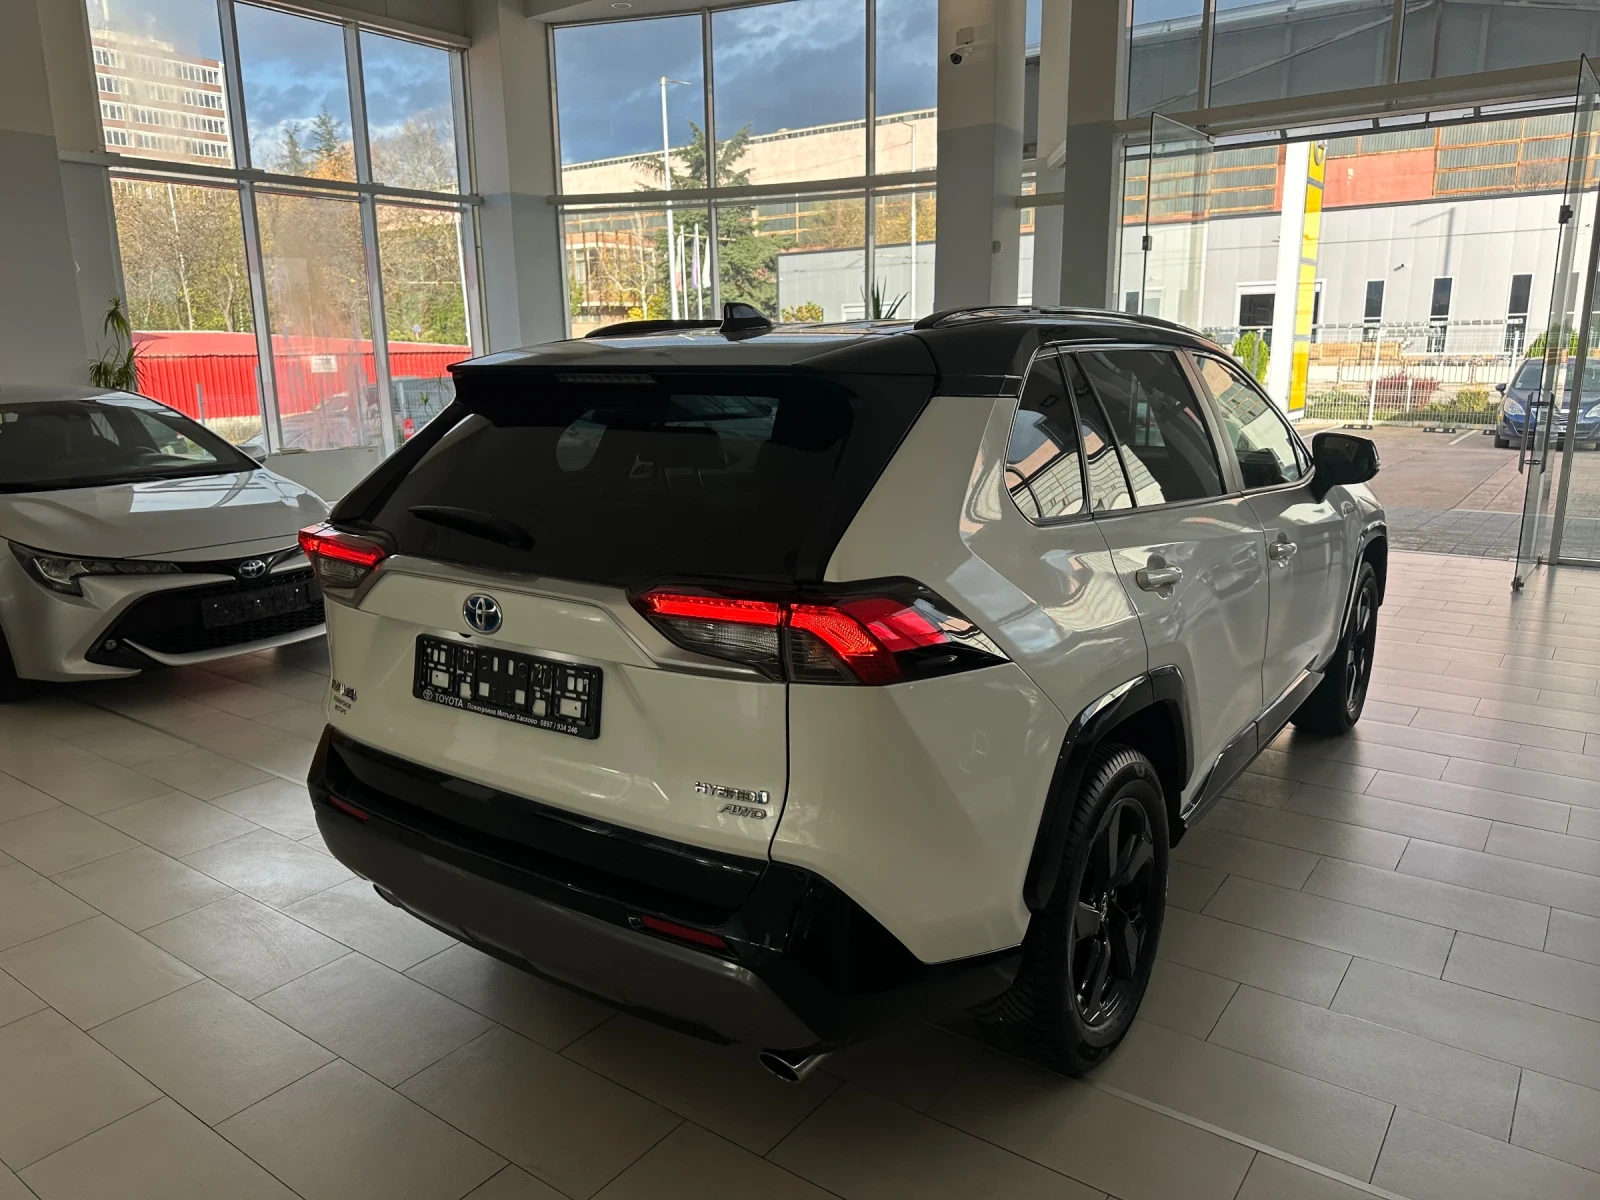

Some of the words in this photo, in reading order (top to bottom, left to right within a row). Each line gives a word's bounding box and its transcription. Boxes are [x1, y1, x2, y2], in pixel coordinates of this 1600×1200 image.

[434, 693, 464, 708] TOYOTA
[516, 713, 538, 725] Хасково
[557, 723, 567, 731] 934
[567, 726, 578, 734] 246
[694, 781, 758, 803] HYBRID
[718, 803, 767, 820] AWD
